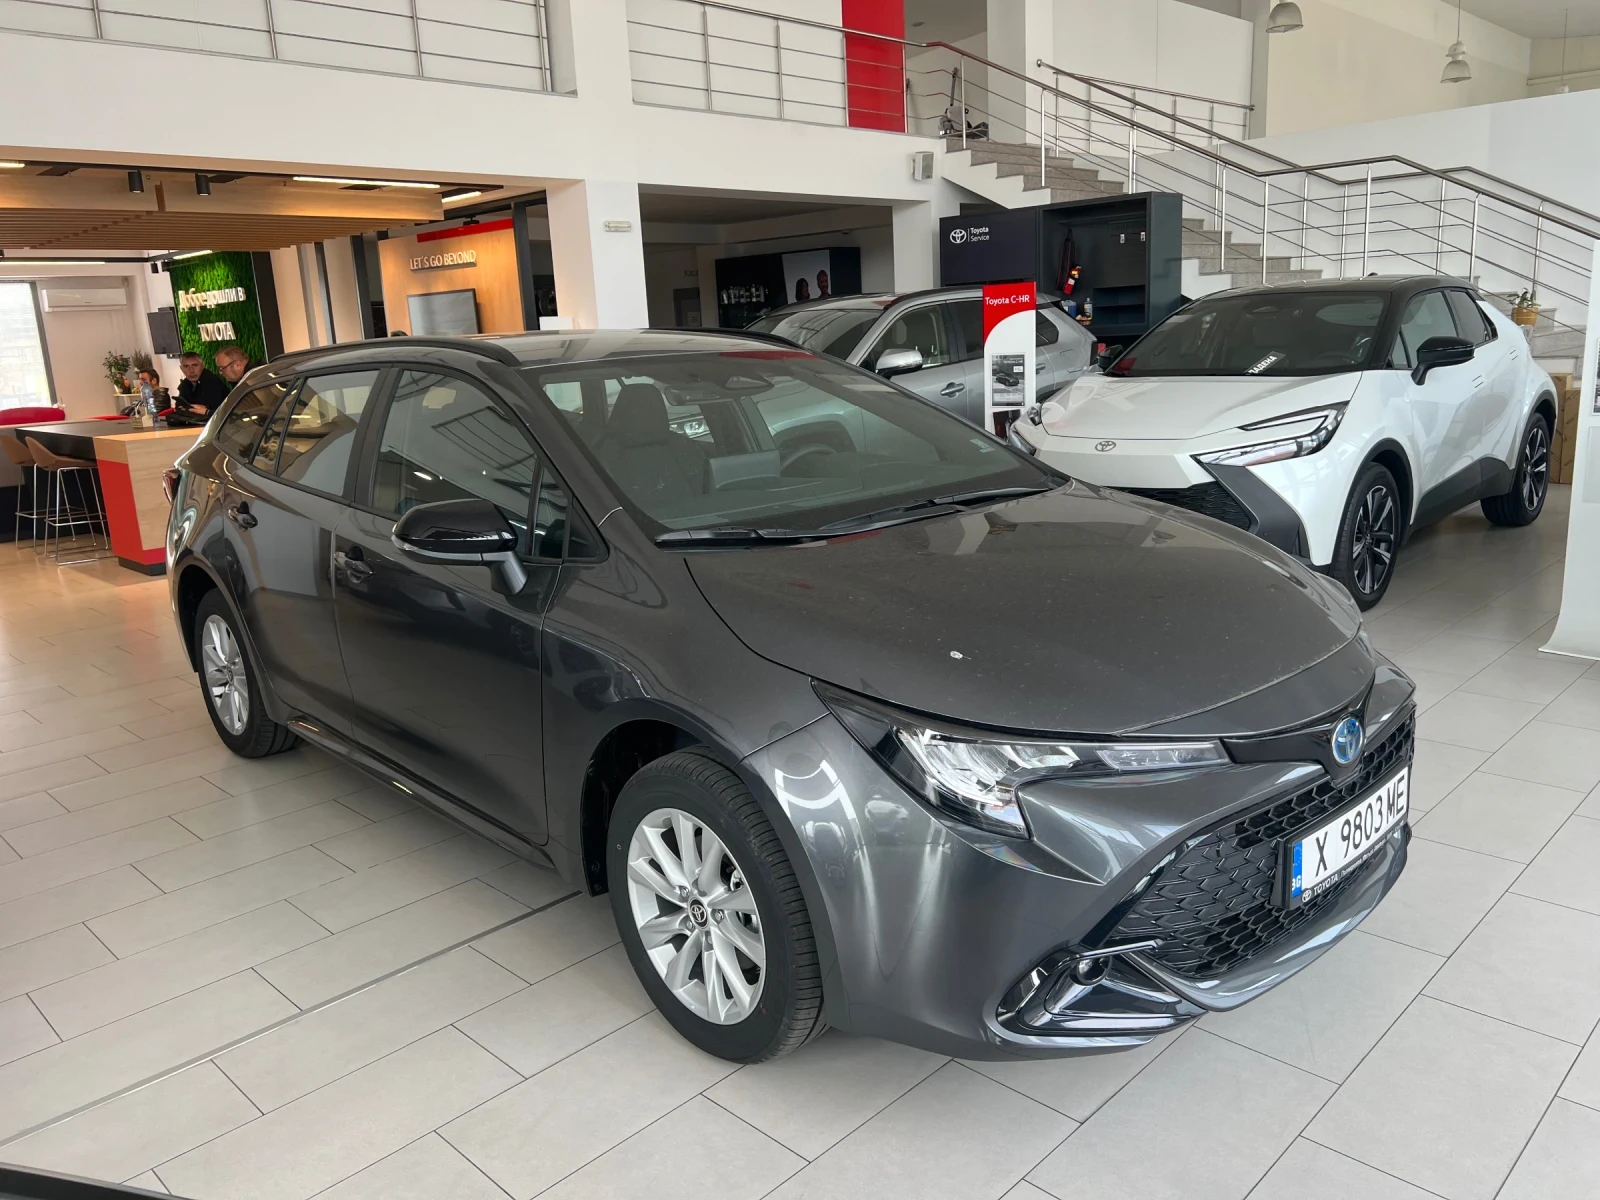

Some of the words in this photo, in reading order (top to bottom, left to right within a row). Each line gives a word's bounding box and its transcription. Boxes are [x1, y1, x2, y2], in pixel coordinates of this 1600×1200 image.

[430, 254, 443, 268] GO
[443, 249, 477, 266] BEYOND
[985, 296, 1010, 306] Toyota
[1010, 294, 1030, 304] C-HR
[197, 321, 237, 342] TOYOTA
[1340, 794, 1383, 859] 9803
[1386, 774, 1405, 825] ME
[1313, 873, 1339, 895] TOYOTA
